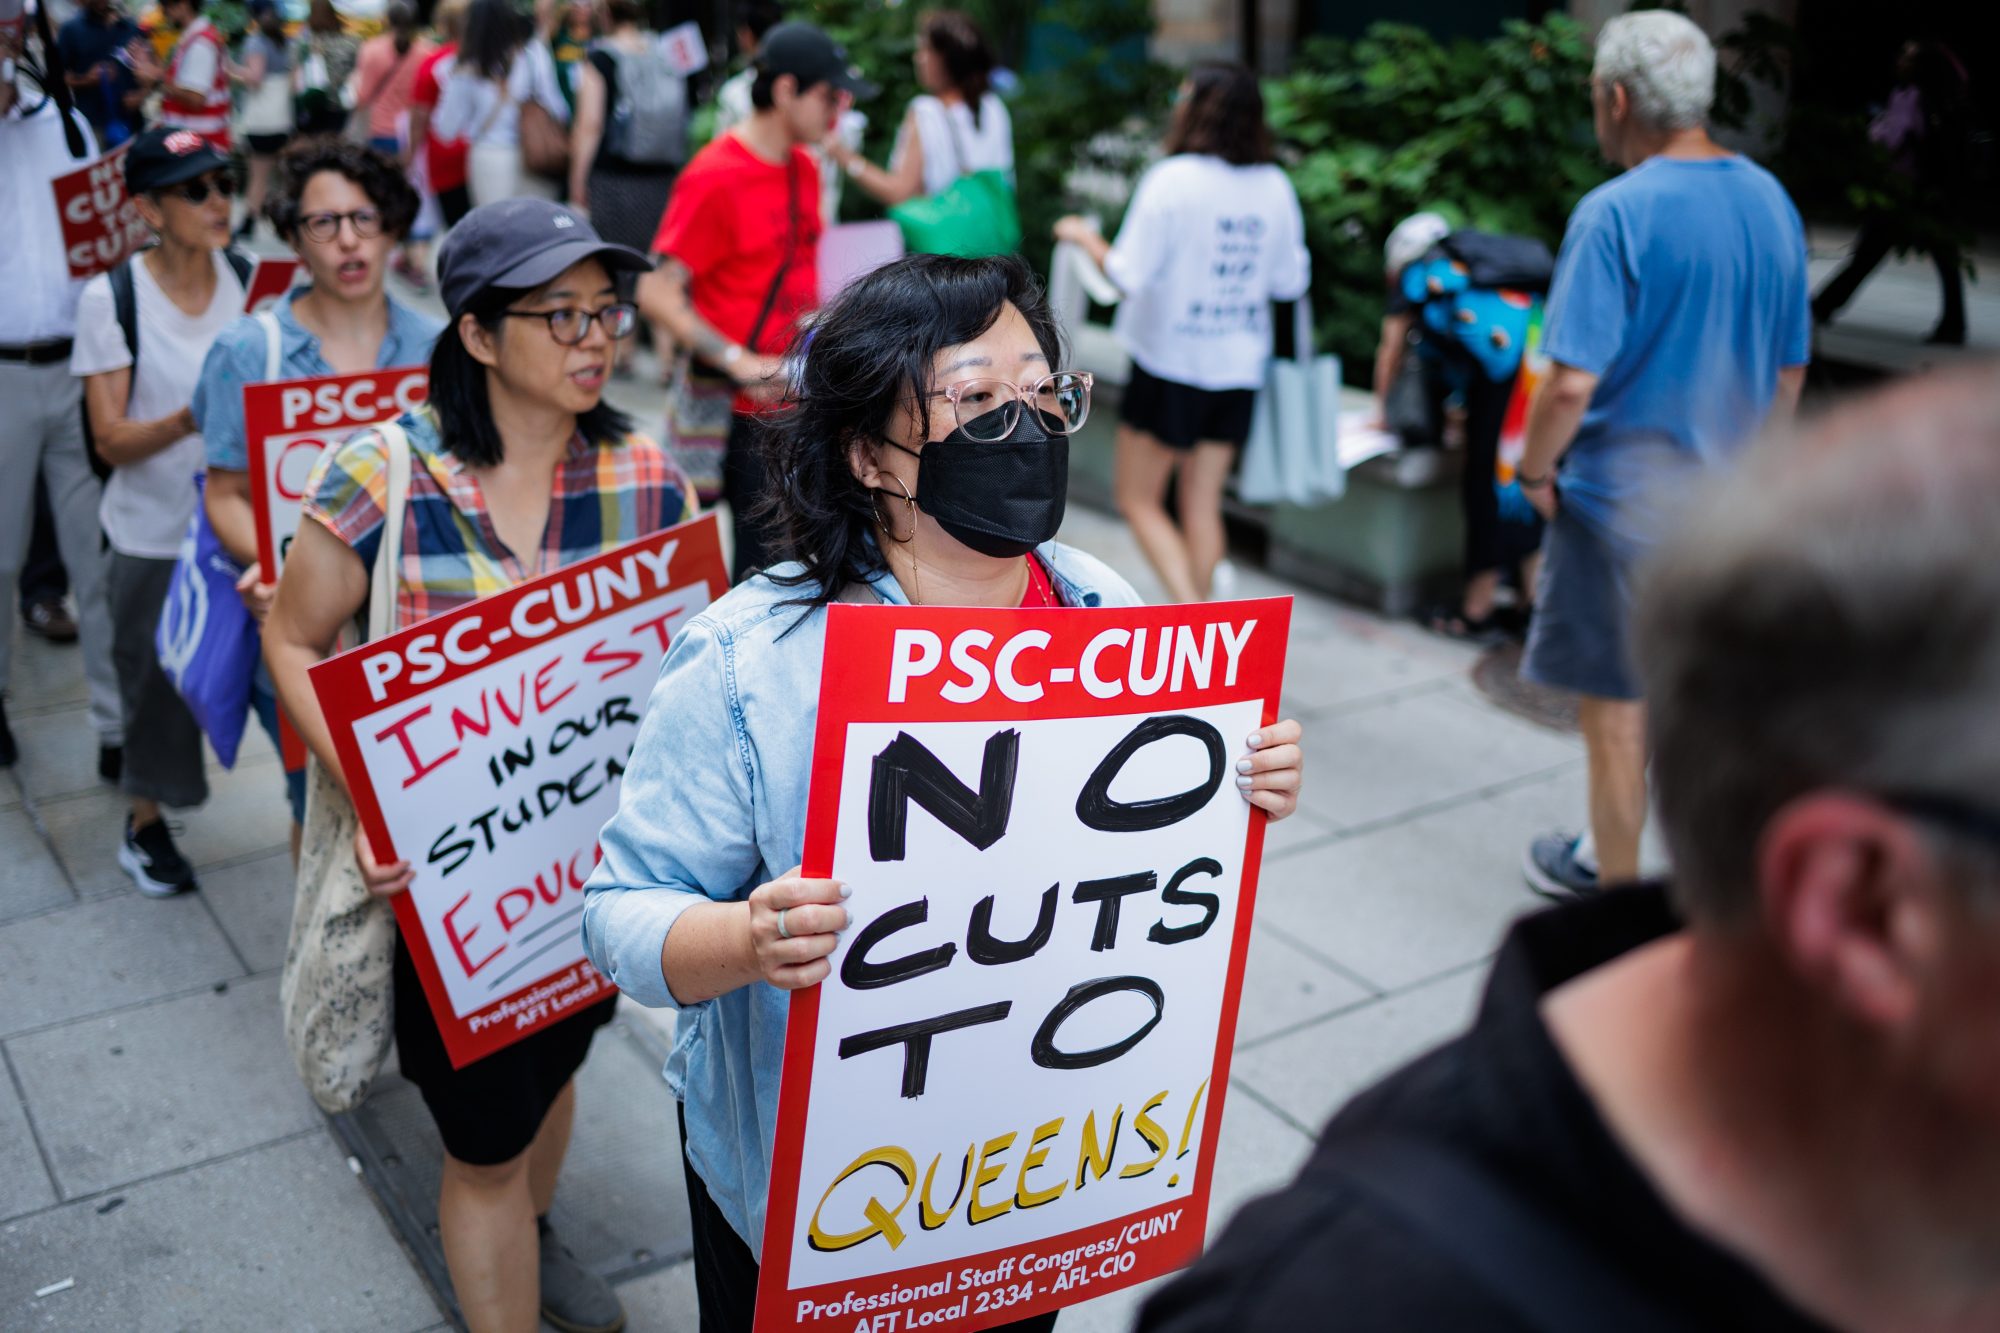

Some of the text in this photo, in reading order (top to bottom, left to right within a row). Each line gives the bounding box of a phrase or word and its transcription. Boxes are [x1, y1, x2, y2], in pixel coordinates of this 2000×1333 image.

[66, 183, 126, 224] CU
[69, 216, 147, 267] CUN
[281, 373, 428, 429] PSC-C
[361, 539, 680, 703] PSC-CUNY
[887, 619, 1258, 704] PSC-CUNY
[374, 604, 686, 789] INVEST
[488, 696, 640, 787] IN OUR
[427, 743, 636, 878] STUDEN
[868, 714, 1227, 862] NO
[442, 841, 604, 980] EDUC
[840, 857, 1223, 990] CUTS
[468, 968, 580, 1034] Professional
[515, 1002, 549, 1031] AFT
[551, 979, 599, 1012] Local
[838, 975, 1165, 1100] TO
[807, 1077, 1210, 1252] QUEENS!
[796, 1209, 1183, 1323] Professional Staff Congress/CUNY
[853, 1311, 902, 1333] AFT
[905, 1296, 969, 1330] Local
[973, 1281, 1033, 1315] 2334
[1051, 1251, 1136, 1295] AFL-CIO
